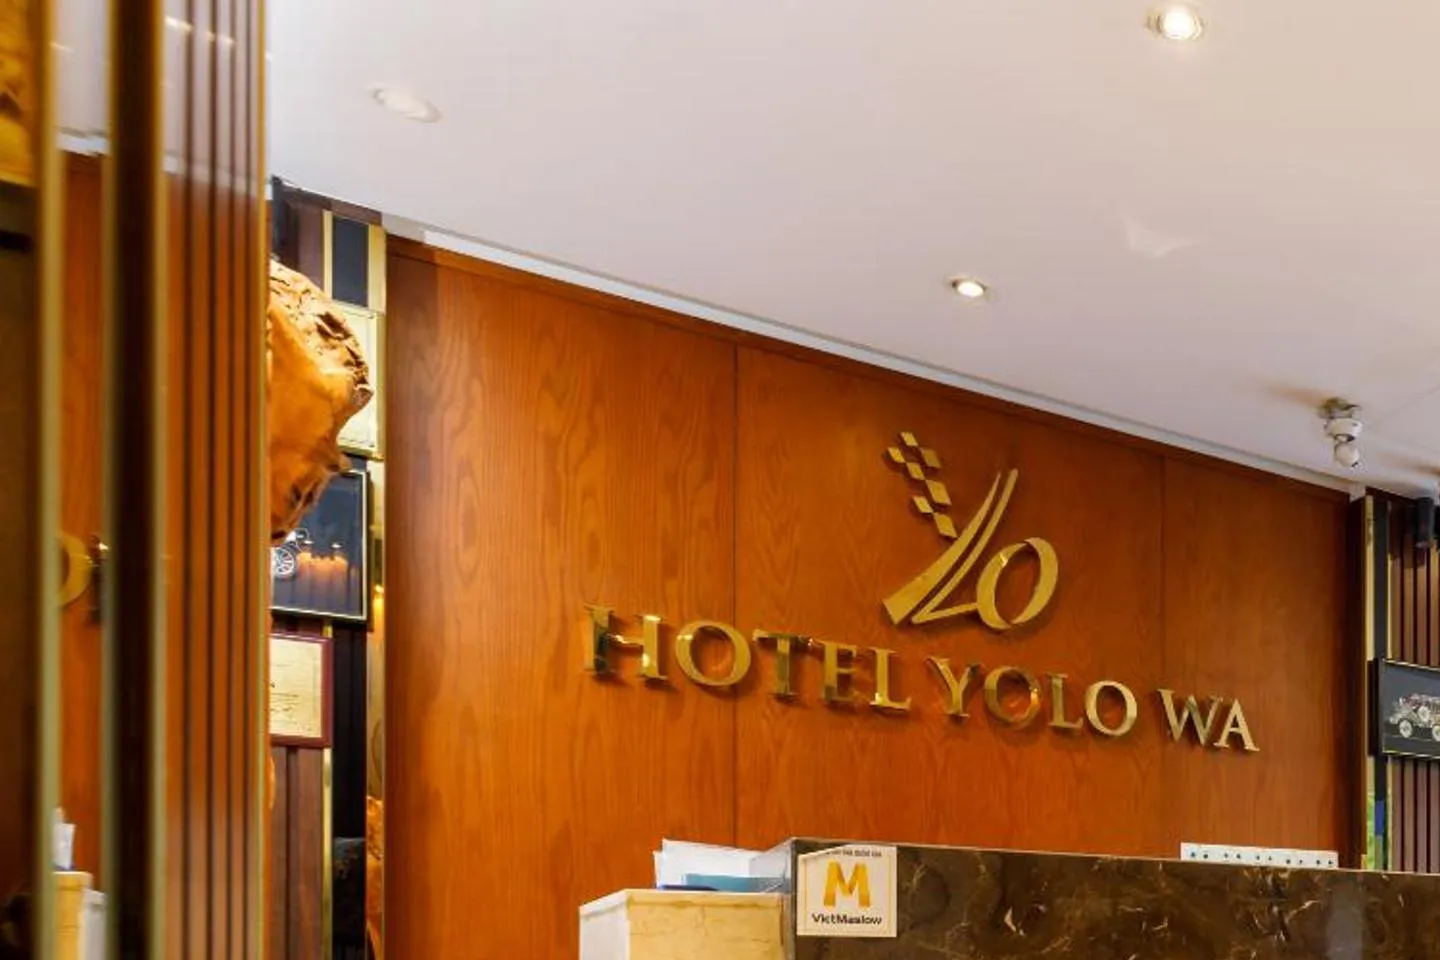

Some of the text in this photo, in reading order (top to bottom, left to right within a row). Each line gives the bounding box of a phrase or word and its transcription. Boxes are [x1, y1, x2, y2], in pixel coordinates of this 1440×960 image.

[583, 605, 1261, 752] HOTEL YOLO WA
[823, 859, 871, 908] M
